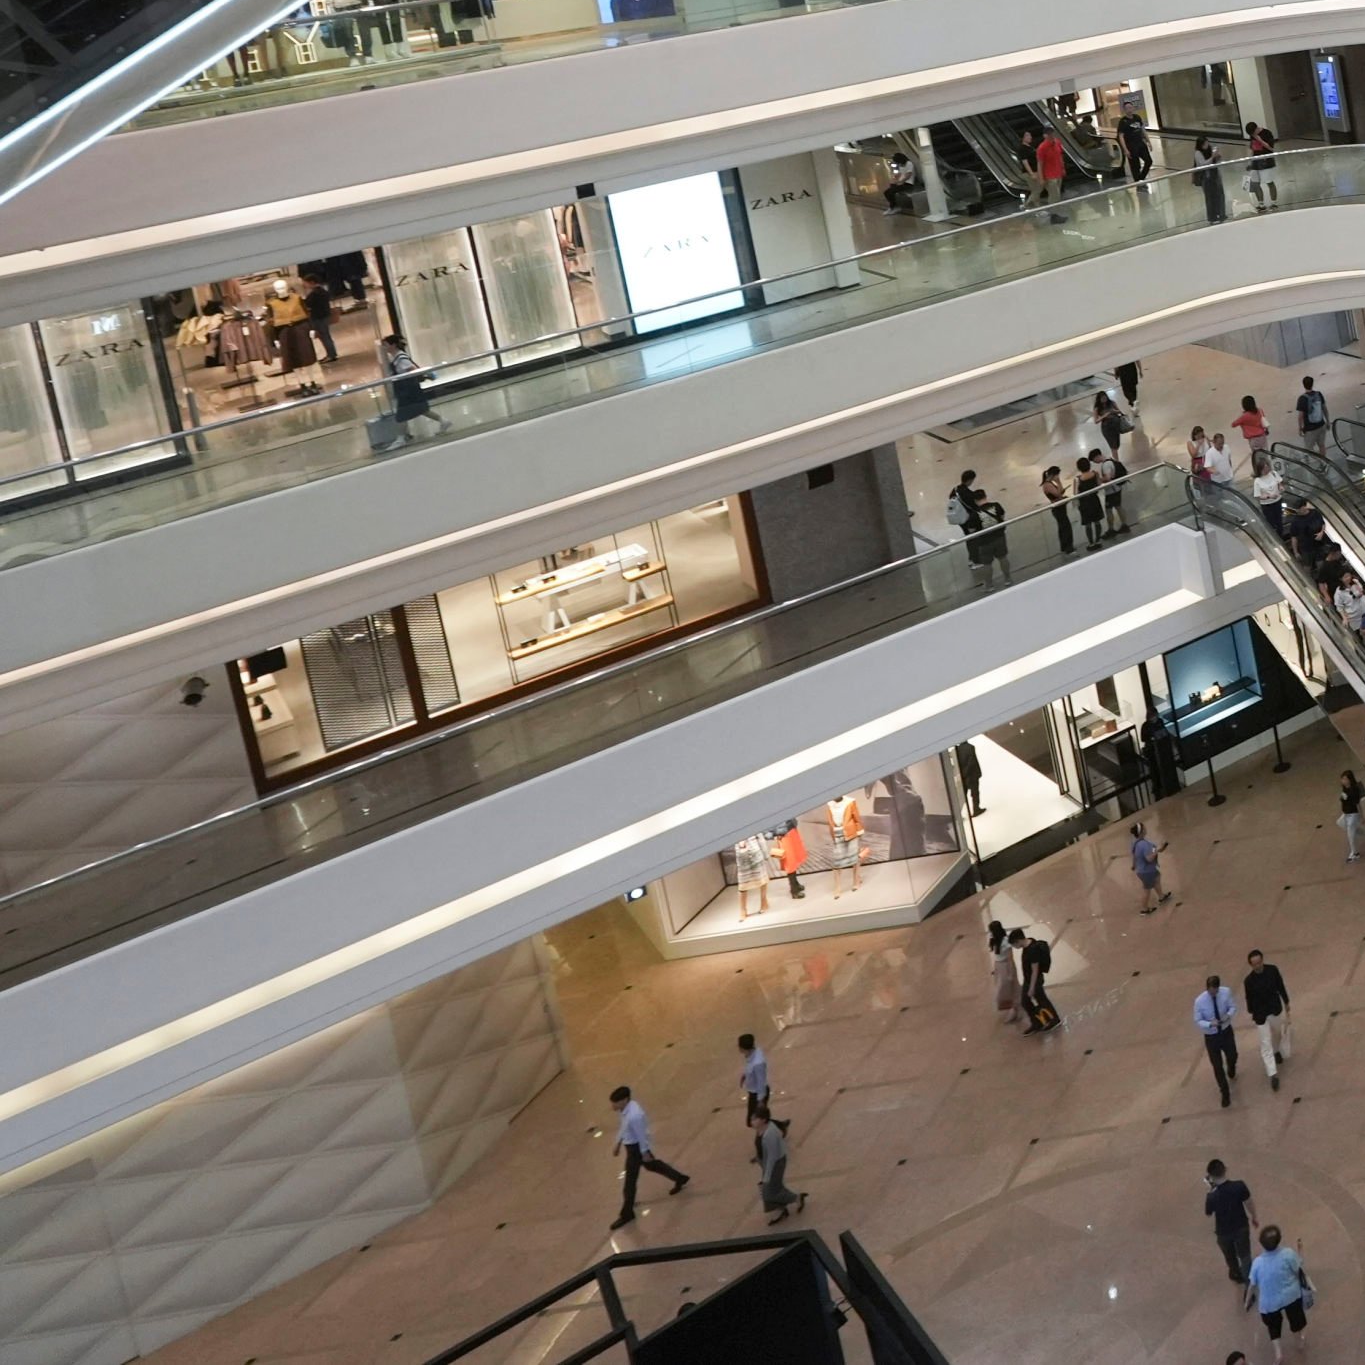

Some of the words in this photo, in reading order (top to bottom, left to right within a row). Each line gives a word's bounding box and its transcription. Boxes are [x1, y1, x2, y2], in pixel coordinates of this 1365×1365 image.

[750, 189, 814, 211] ZARA
[396, 262, 472, 287] ZARA
[55, 338, 145, 367] ZARA
